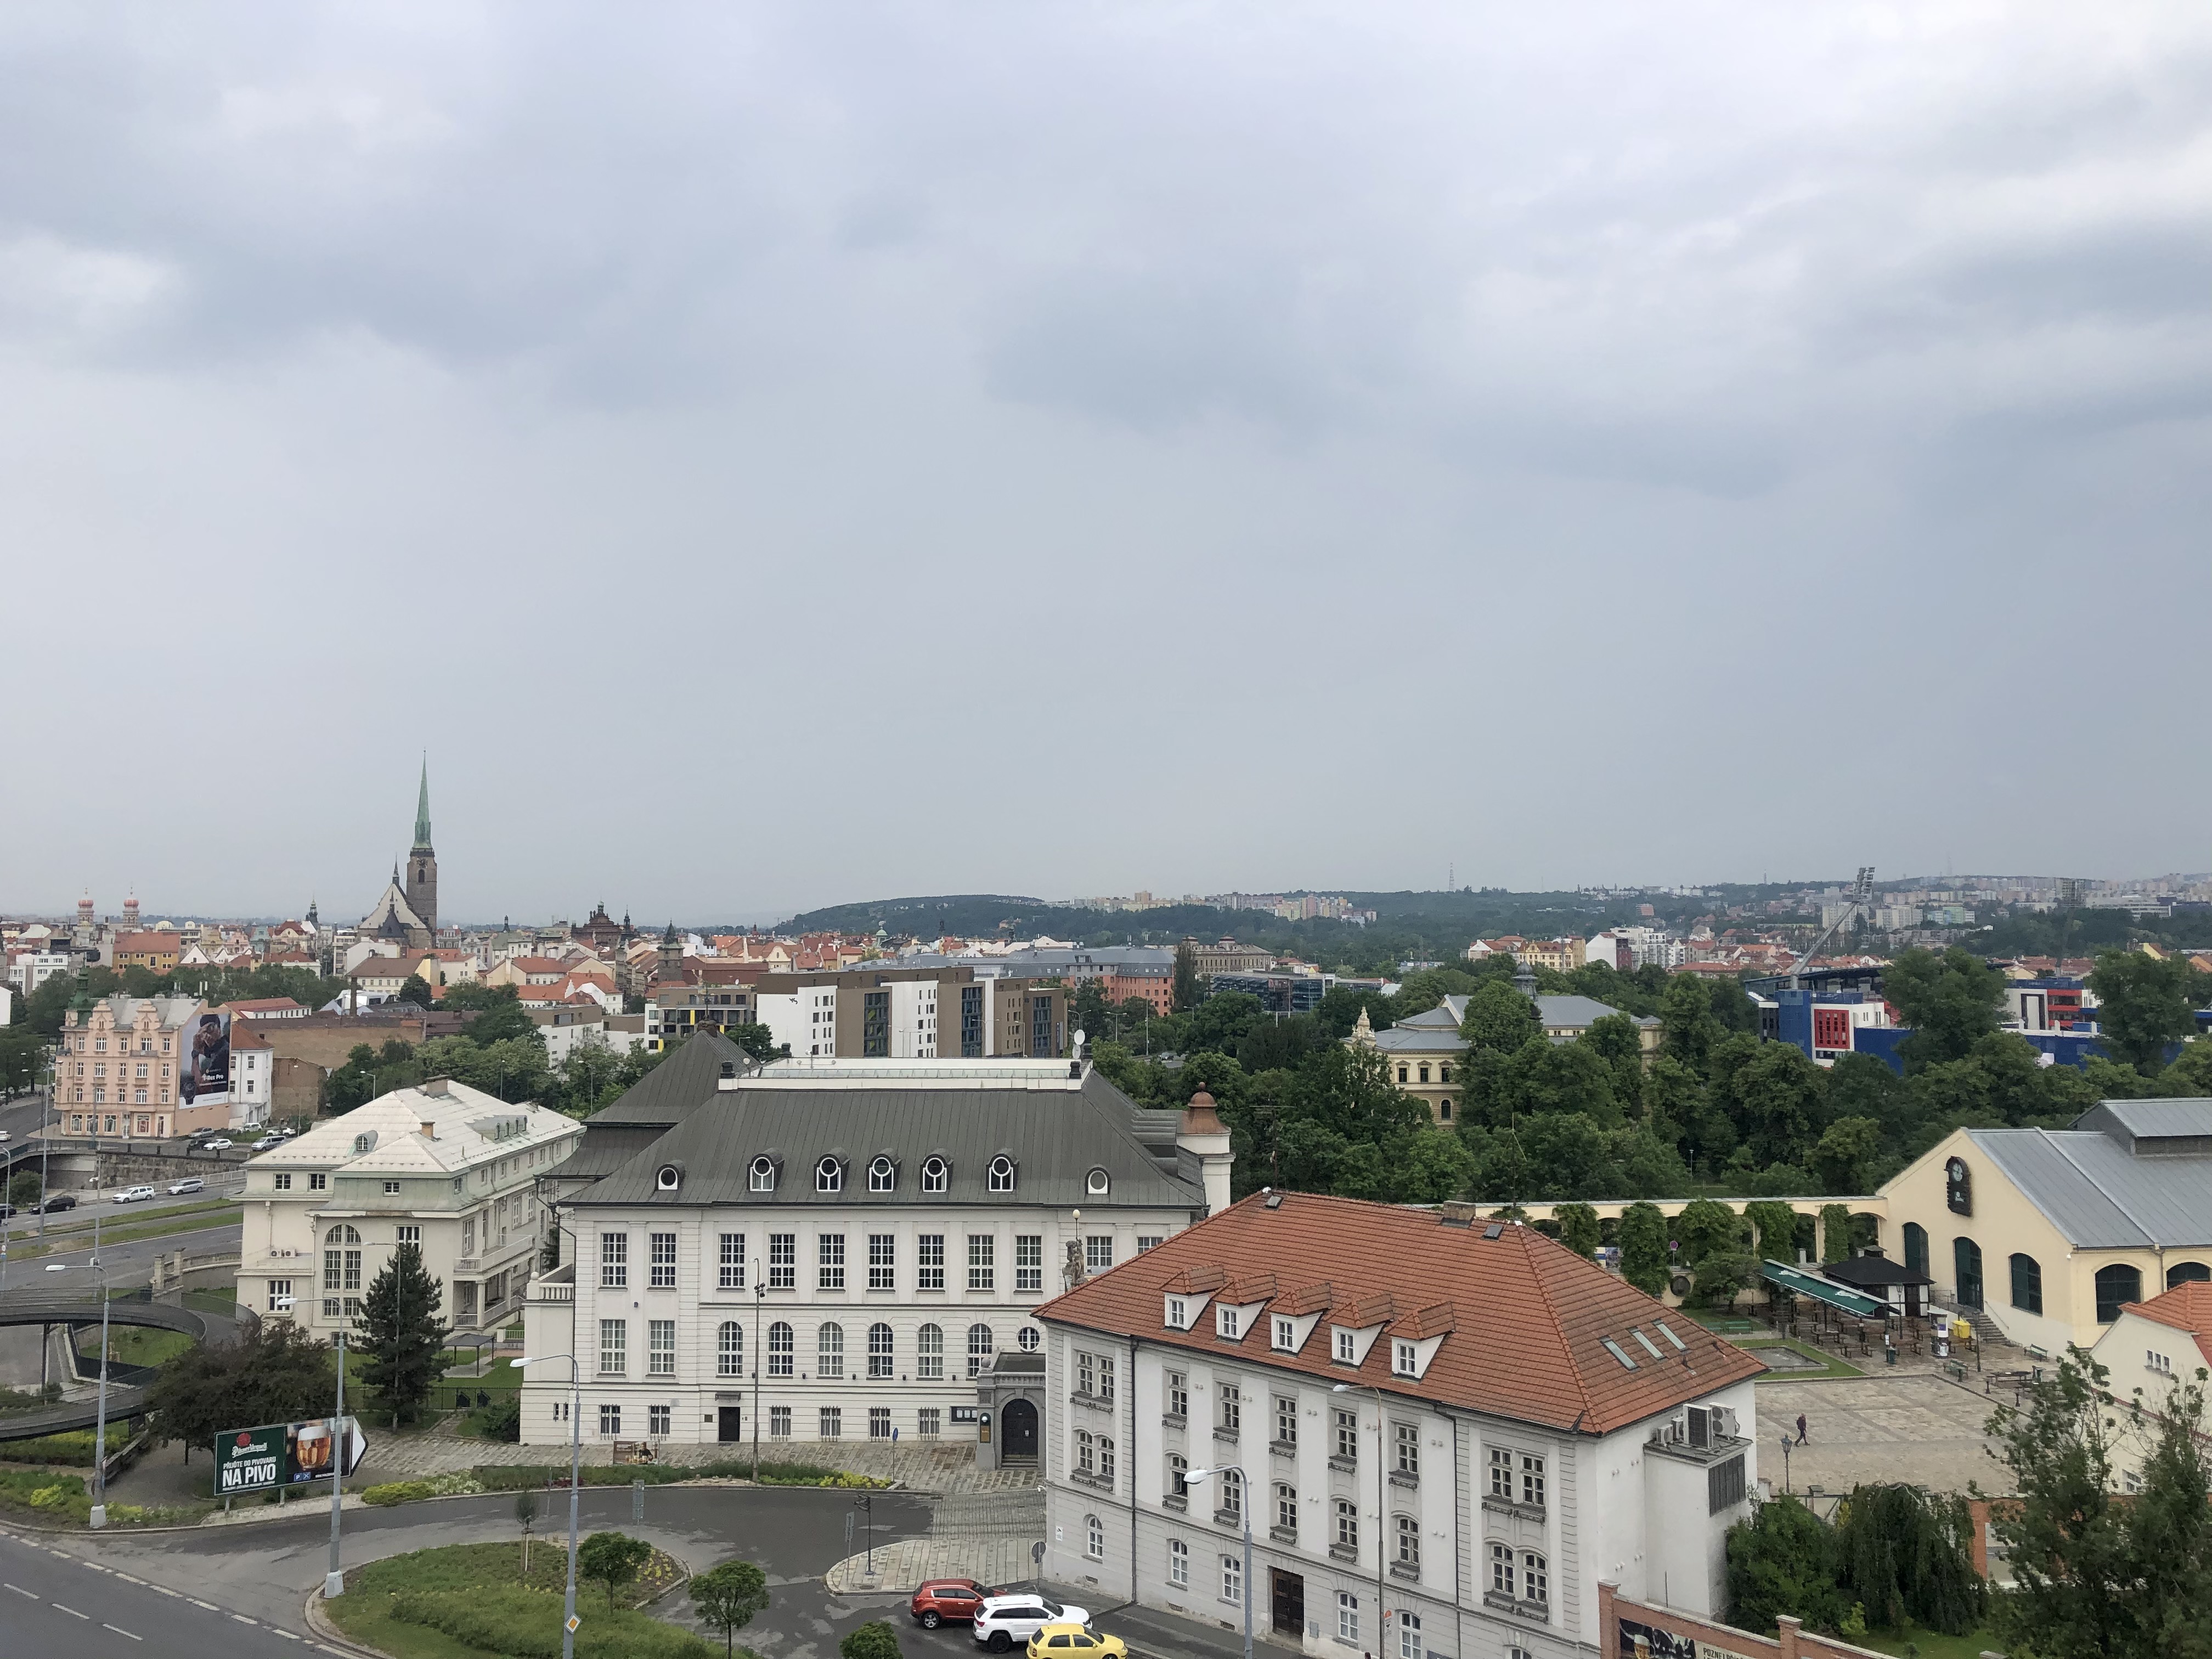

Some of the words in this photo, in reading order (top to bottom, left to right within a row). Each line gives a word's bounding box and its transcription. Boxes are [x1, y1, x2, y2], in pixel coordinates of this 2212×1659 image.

[232, 1446, 250, 1458] Pilsner
[250, 1442, 267, 1452] Urquell
[252, 1457, 276, 1465] PIVOVARU
[223, 1469, 242, 1487] NA
[245, 1464, 275, 1483] PIVO
